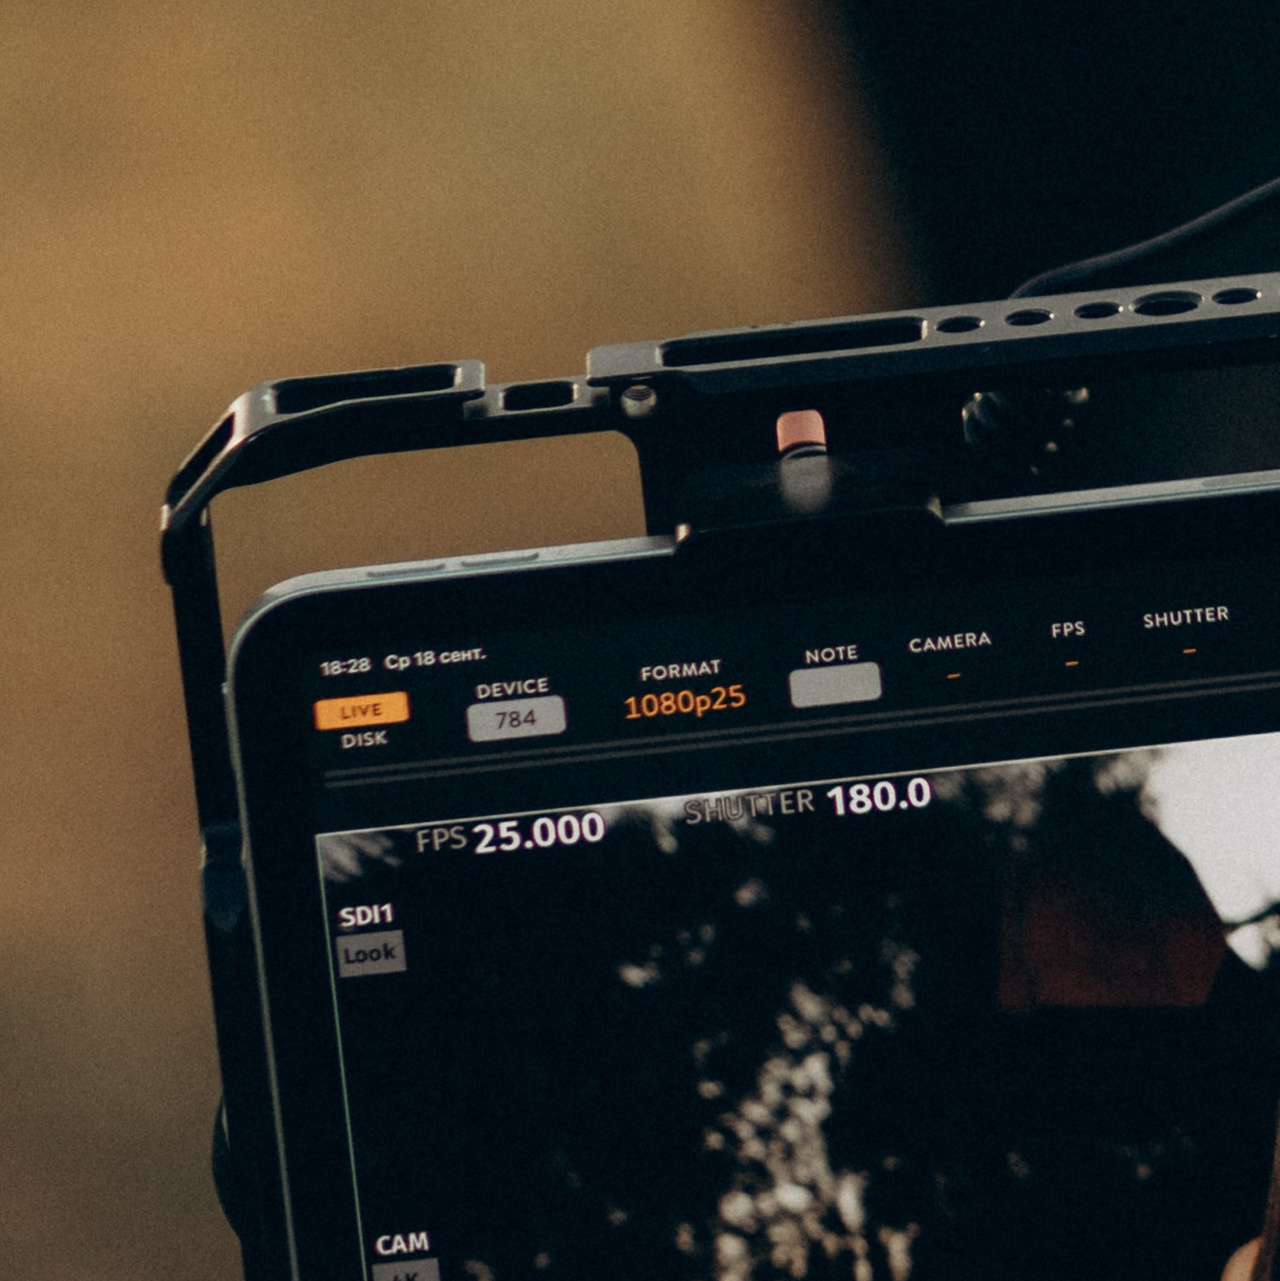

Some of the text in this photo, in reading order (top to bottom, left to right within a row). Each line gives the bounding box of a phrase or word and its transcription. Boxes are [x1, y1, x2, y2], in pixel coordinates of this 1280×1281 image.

[1143, 605, 1229, 629] SHUTTER
[1051, 621, 1085, 638] FPS
[909, 631, 992, 654] CAMERA
[320, 657, 371, 676] 18:28
[415, 651, 435, 667] 18
[439, 647, 486, 665] сент.
[805, 645, 858, 664] NOTE
[641, 659, 721, 681] FORMAT
[476, 677, 549, 700] DEVICE
[341, 702, 382, 720] LIVE
[624, 684, 746, 720] 1080p25
[496, 709, 537, 730] 784
[341, 731, 387, 749] DISK
[683, 776, 932, 825] SHUTTER 180.0
[416, 811, 606, 855] FPS 25.000
[338, 902, 394, 928] SDI1
[343, 942, 396, 966] Look
[375, 1231, 430, 1256] CAM
